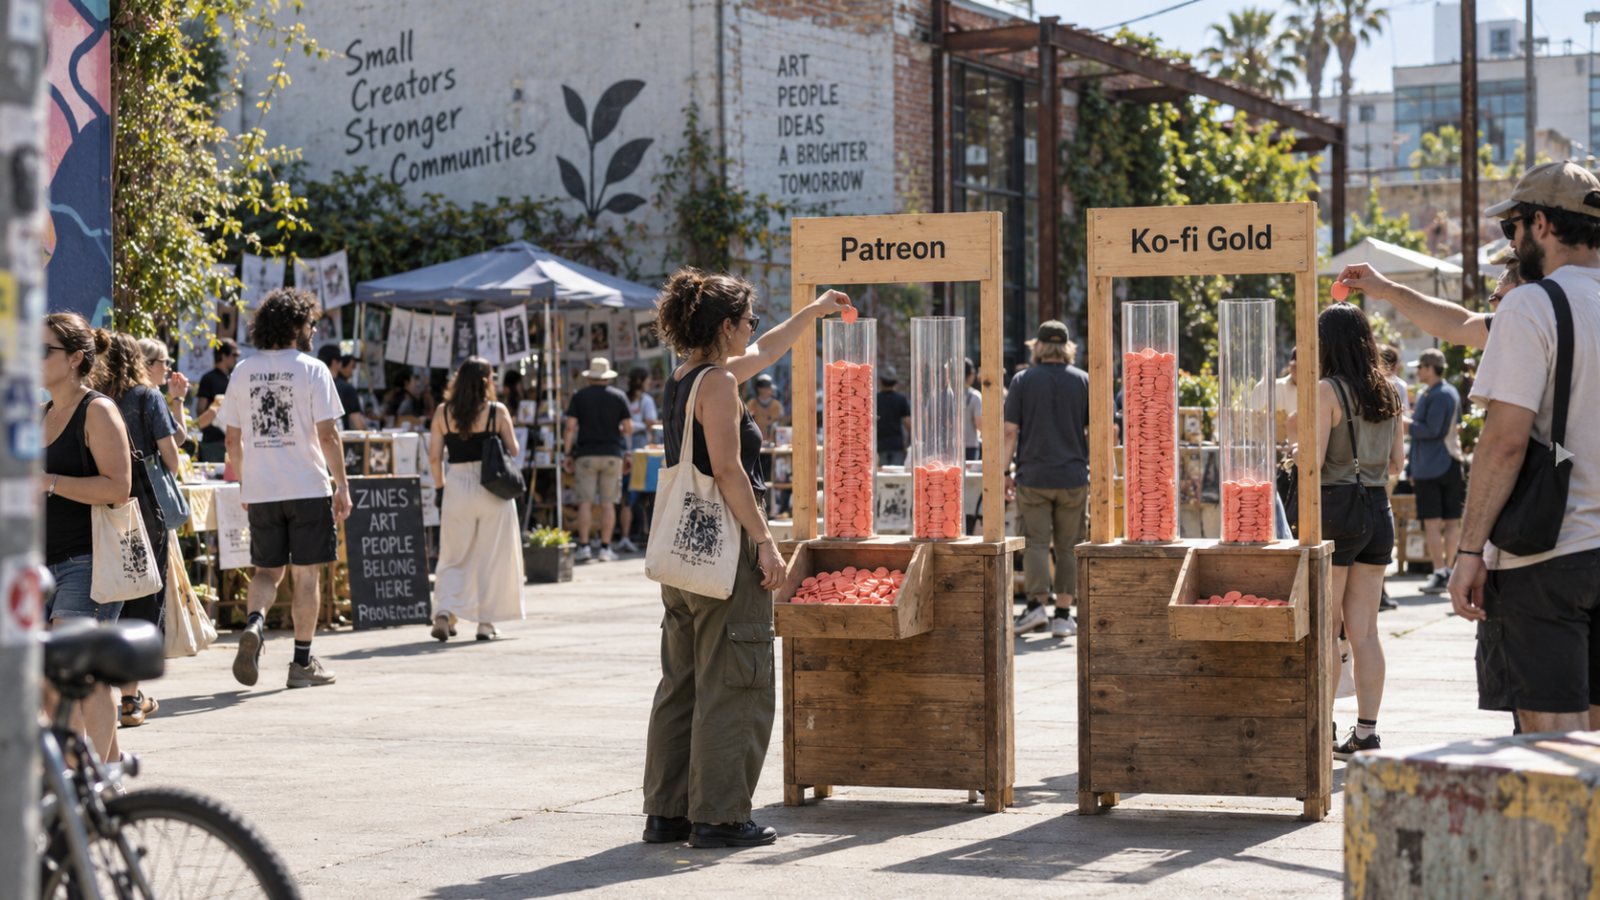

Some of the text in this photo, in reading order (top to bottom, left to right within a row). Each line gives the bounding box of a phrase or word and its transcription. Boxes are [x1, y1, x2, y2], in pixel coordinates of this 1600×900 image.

[345, 29, 413, 76] Small
[777, 54, 810, 77] ART
[352, 68, 456, 112] Creators
[778, 84, 839, 108] PEOPLE
[345, 106, 463, 155] Stronger
[778, 114, 825, 137] IDEAS
[390, 132, 536, 187] Communities
[778, 141, 868, 166] A BRIGHTER
[779, 170, 864, 195] TOMORROW
[841, 236, 945, 262] Patreon
[1132, 224, 1272, 254] Ko-fi Gold
[355, 488, 409, 509] ZINES
[369, 512, 398, 532] ART
[362, 535, 414, 555] PEOPLE
[363, 559, 416, 578] BELONG
[375, 579, 414, 599] HERE
